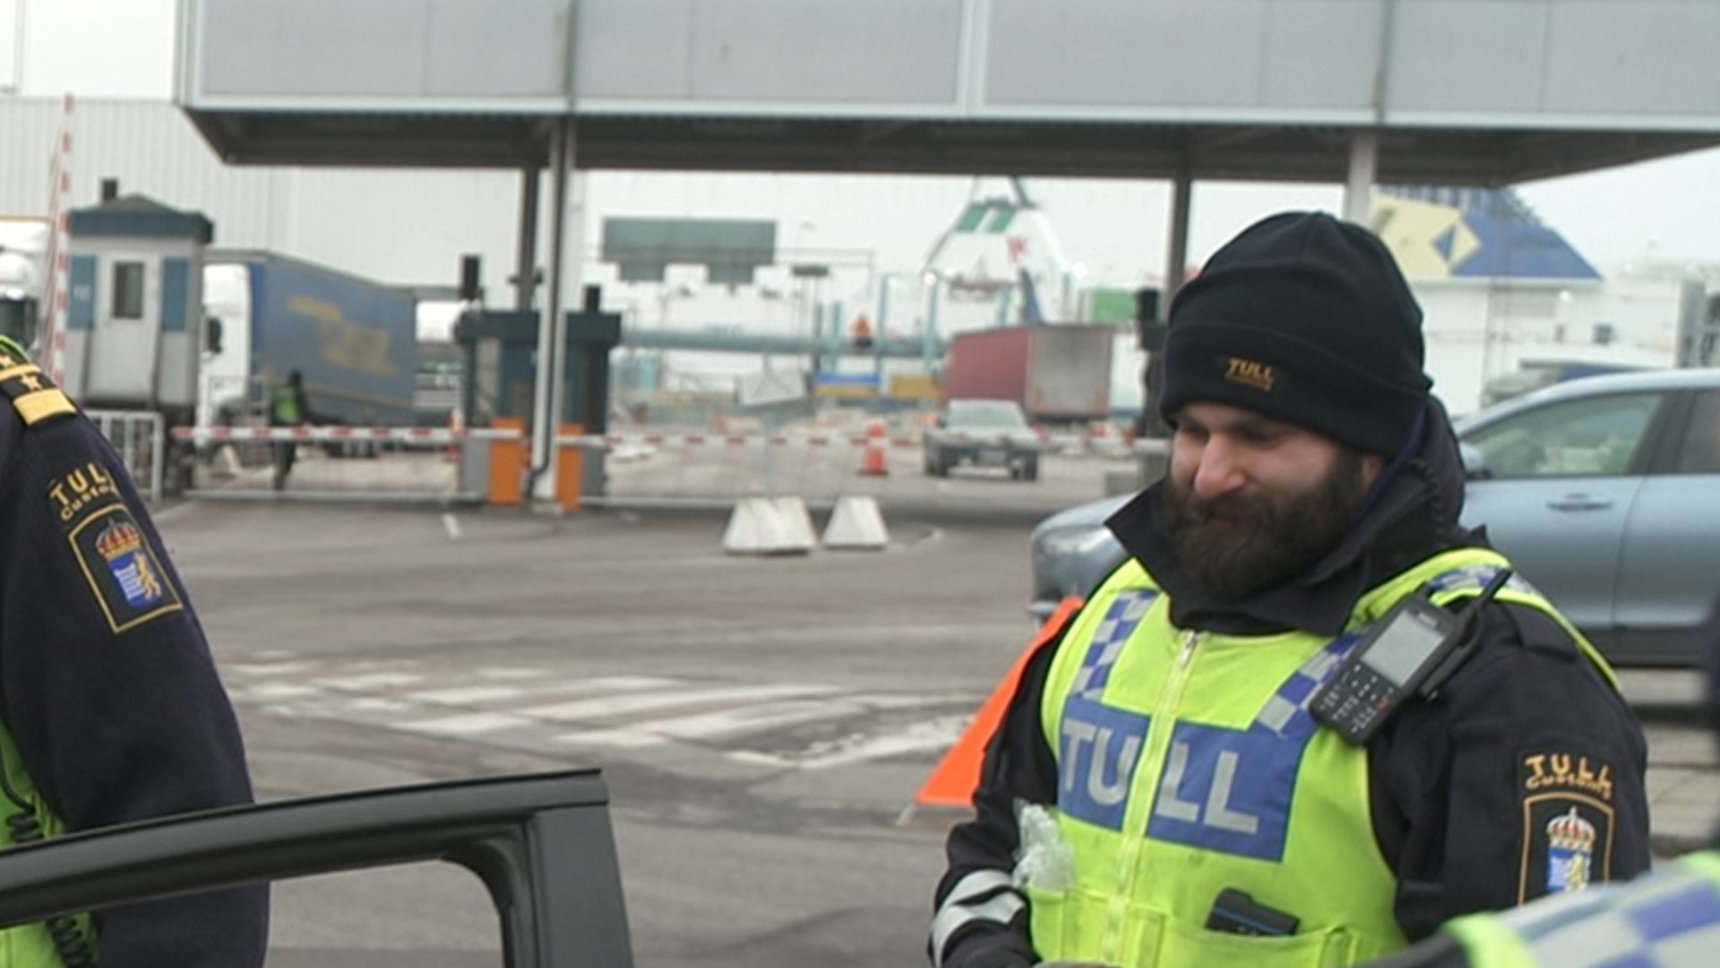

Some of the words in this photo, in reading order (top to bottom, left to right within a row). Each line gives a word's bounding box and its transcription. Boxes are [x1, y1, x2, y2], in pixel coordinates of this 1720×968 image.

[1229, 357, 1274, 383] TULL
[1061, 717, 1259, 835] TULL
[1525, 753, 1612, 789] TULL
